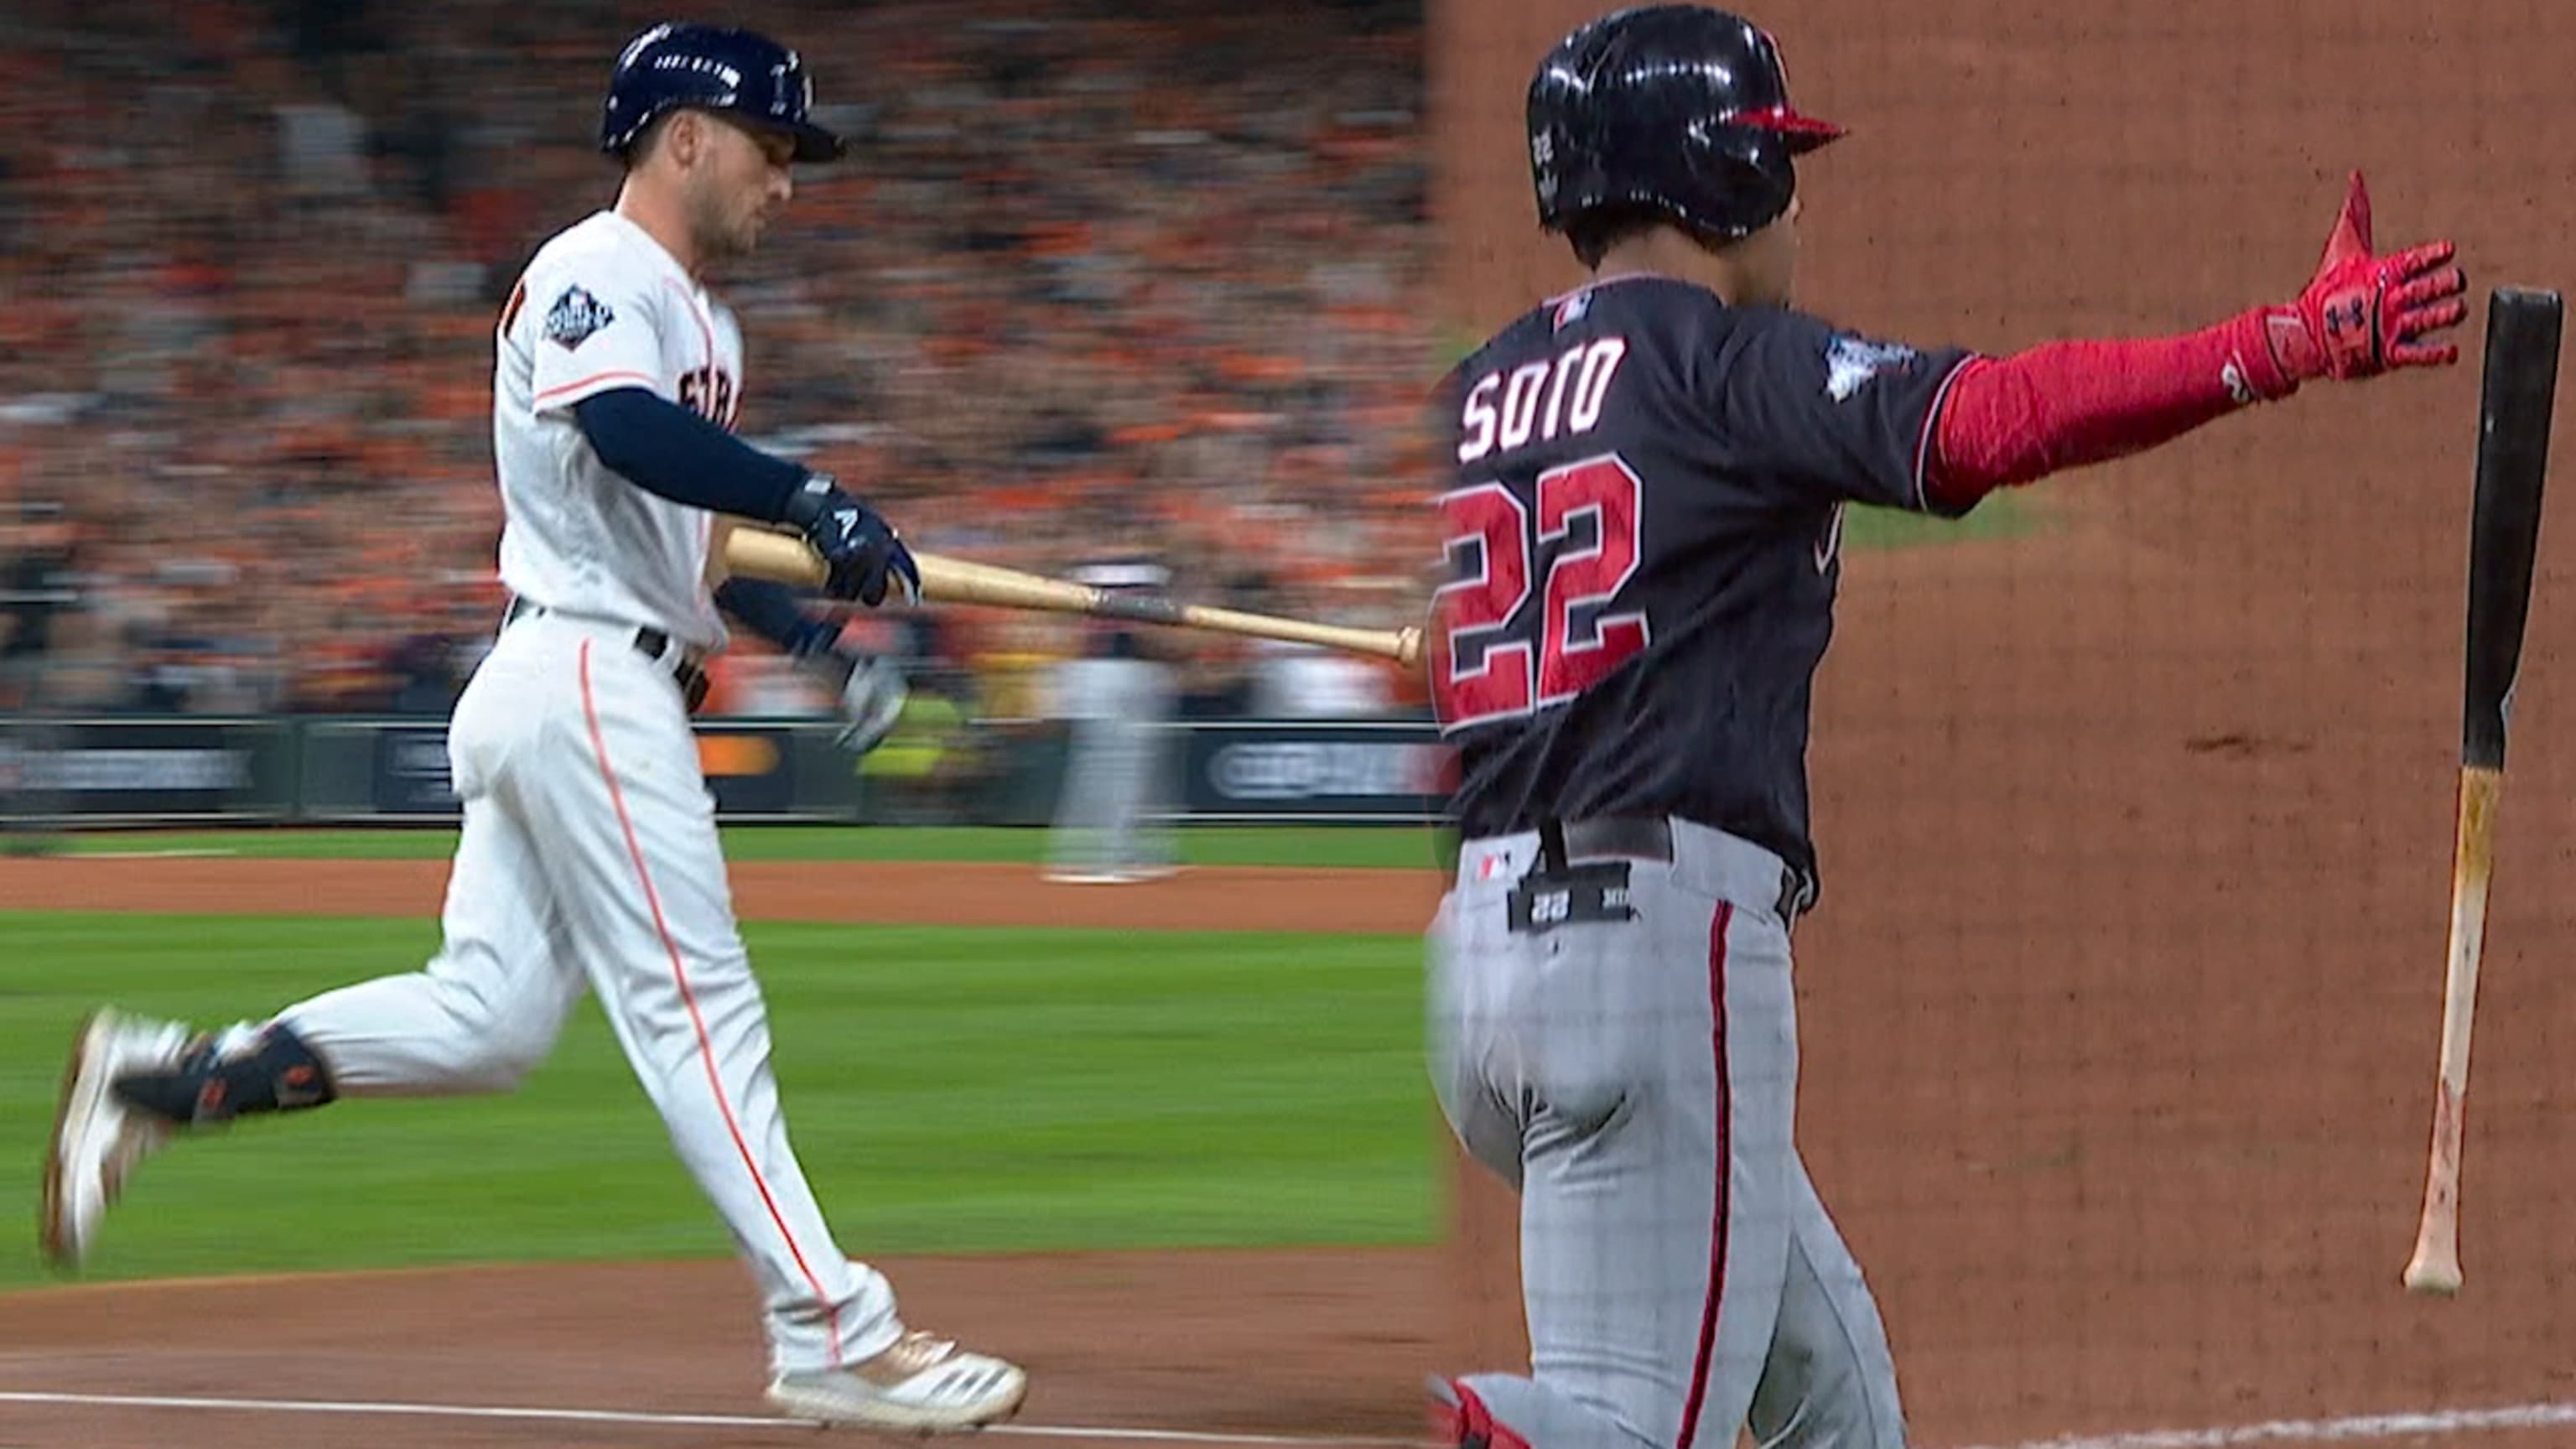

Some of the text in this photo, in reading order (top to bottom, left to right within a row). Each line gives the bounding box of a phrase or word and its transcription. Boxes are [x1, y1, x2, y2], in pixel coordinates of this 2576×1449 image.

[674, 366, 743, 433] STR
[1457, 336, 1628, 464] SOTO
[1425, 451, 1651, 738] 22
